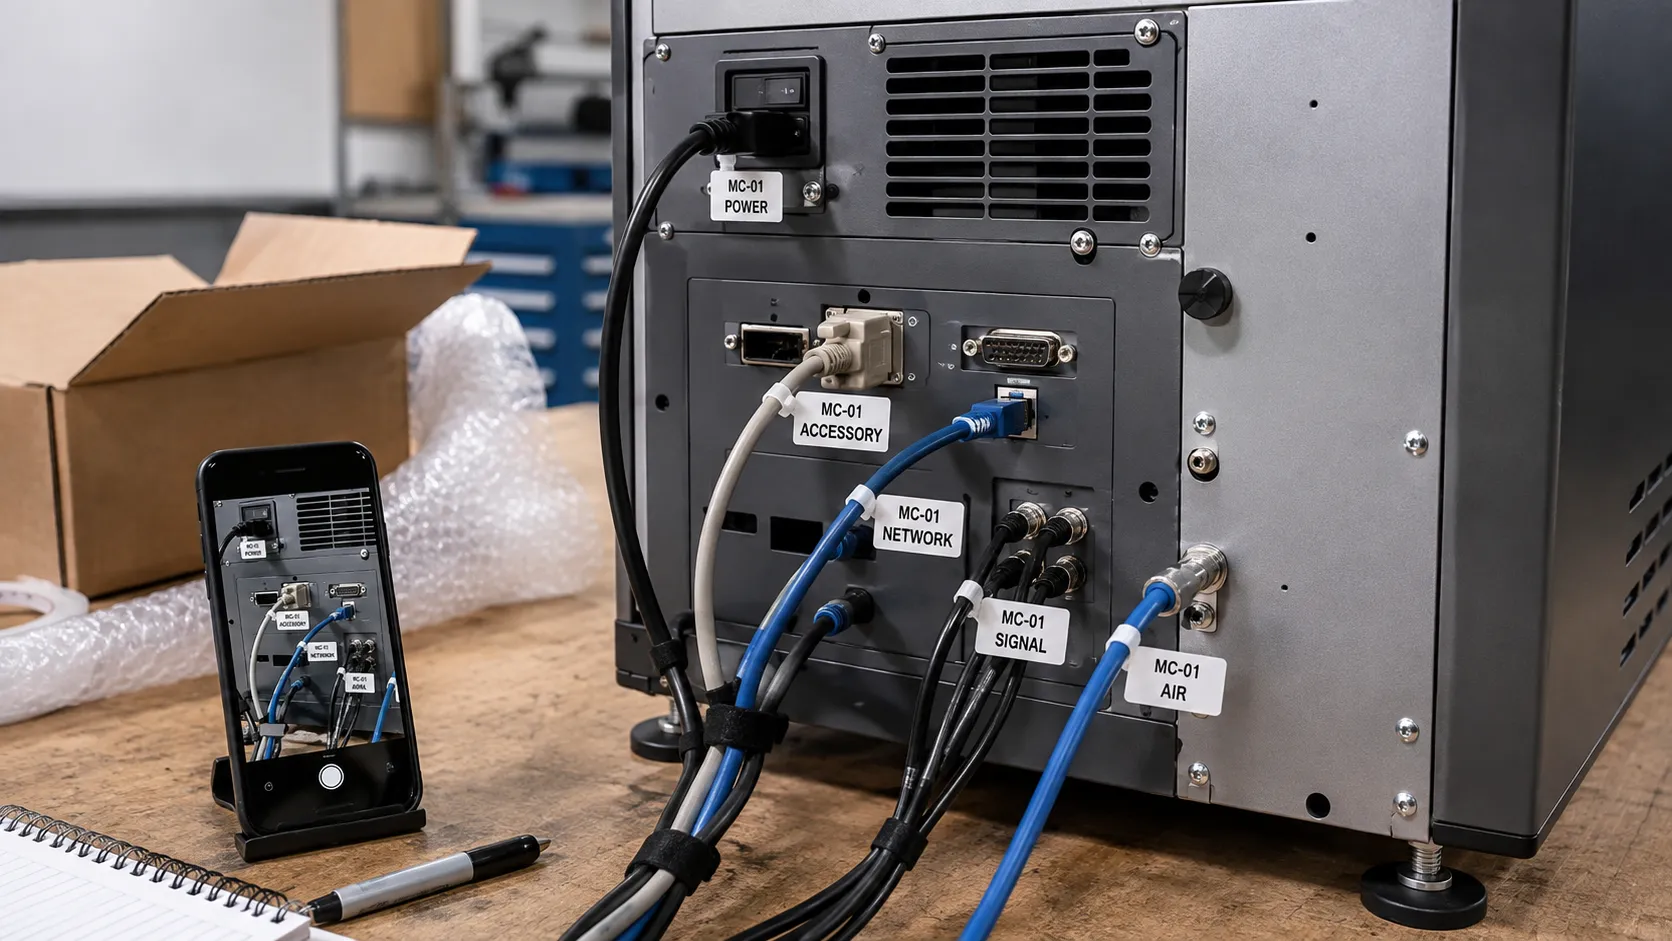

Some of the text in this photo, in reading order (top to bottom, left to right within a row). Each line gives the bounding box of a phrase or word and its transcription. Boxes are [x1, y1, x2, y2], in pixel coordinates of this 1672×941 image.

[728, 179, 764, 193] MC-01
[724, 200, 768, 214] POWER
[821, 401, 862, 419] MC-01
[799, 423, 884, 443] ACCESSORY
[898, 505, 940, 524] MC-01
[882, 525, 954, 548] NETWORK
[1001, 609, 1045, 630] MC-01
[994, 633, 1047, 654] SIGNAL
[1154, 658, 1200, 680] MC-01
[1160, 682, 1187, 702] AIR
